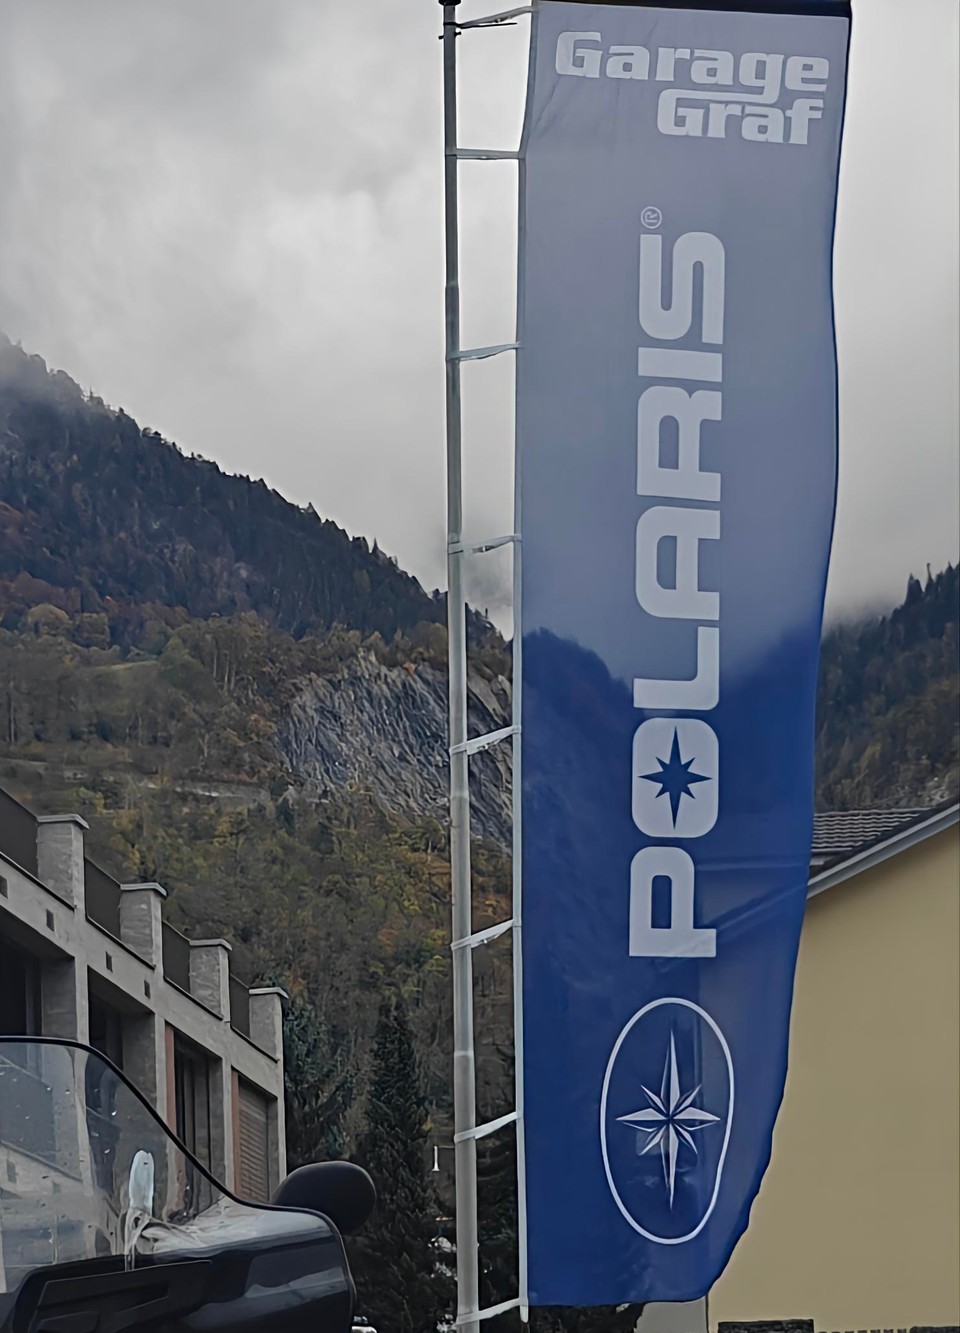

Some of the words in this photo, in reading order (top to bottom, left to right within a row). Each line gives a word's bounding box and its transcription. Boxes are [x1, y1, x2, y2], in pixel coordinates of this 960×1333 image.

[555, 31, 830, 104] Garage
[656, 88, 824, 145] Graf
[628, 230, 725, 958] POLARIS
